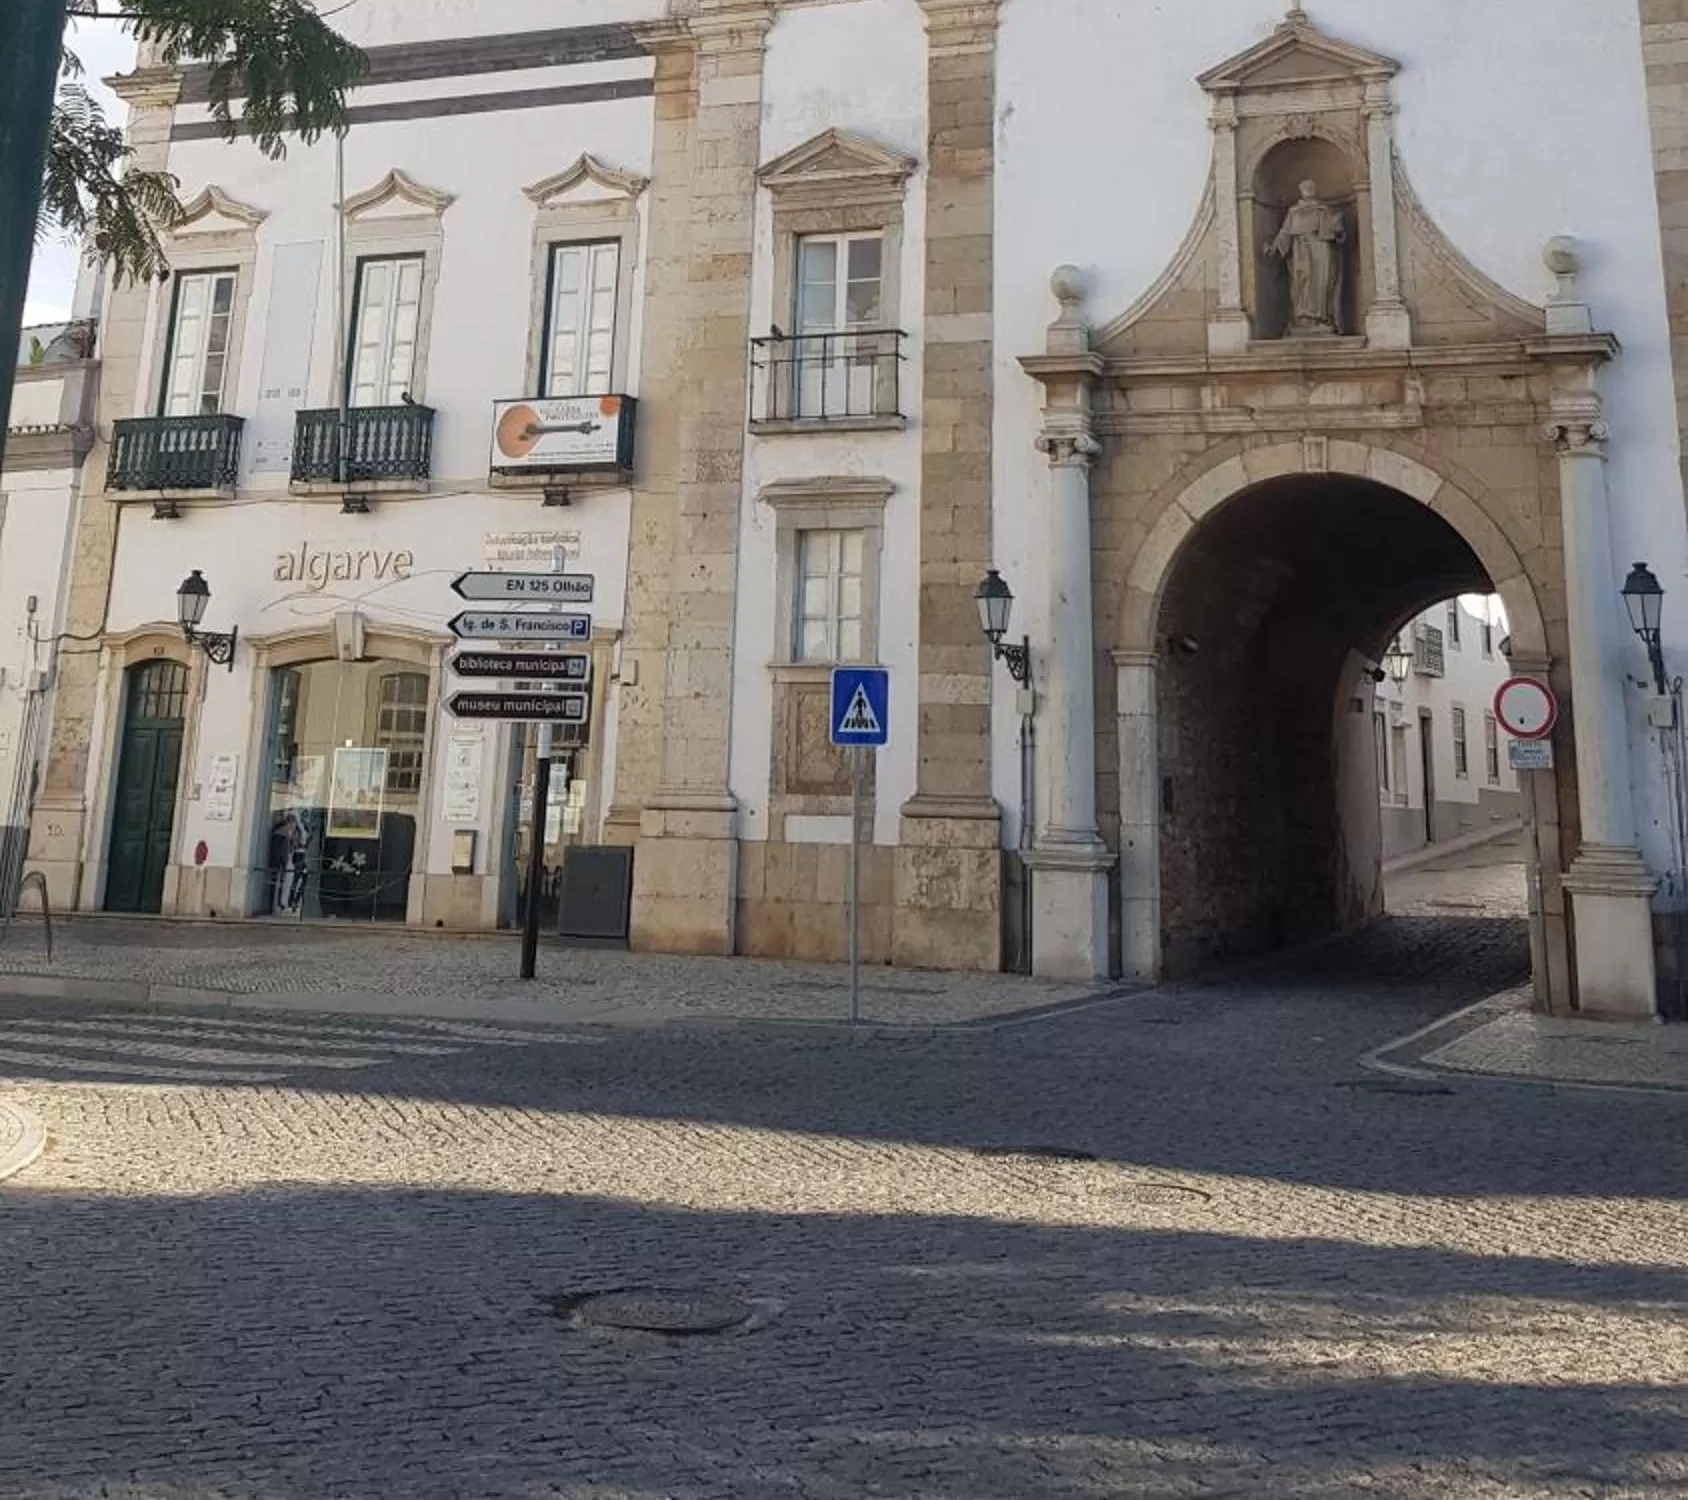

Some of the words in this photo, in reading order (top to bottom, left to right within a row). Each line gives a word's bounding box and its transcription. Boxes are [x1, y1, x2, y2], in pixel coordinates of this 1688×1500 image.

[274, 540, 413, 592] algarve
[506, 579, 525, 591] EN
[529, 580, 549, 592] 125
[553, 580, 589, 593] Olhão
[481, 617, 495, 630] de
[515, 618, 571, 631] Francisco
[459, 657, 513, 669] biblioteca
[457, 699, 500, 711] museu
[503, 699, 565, 714] municipal
